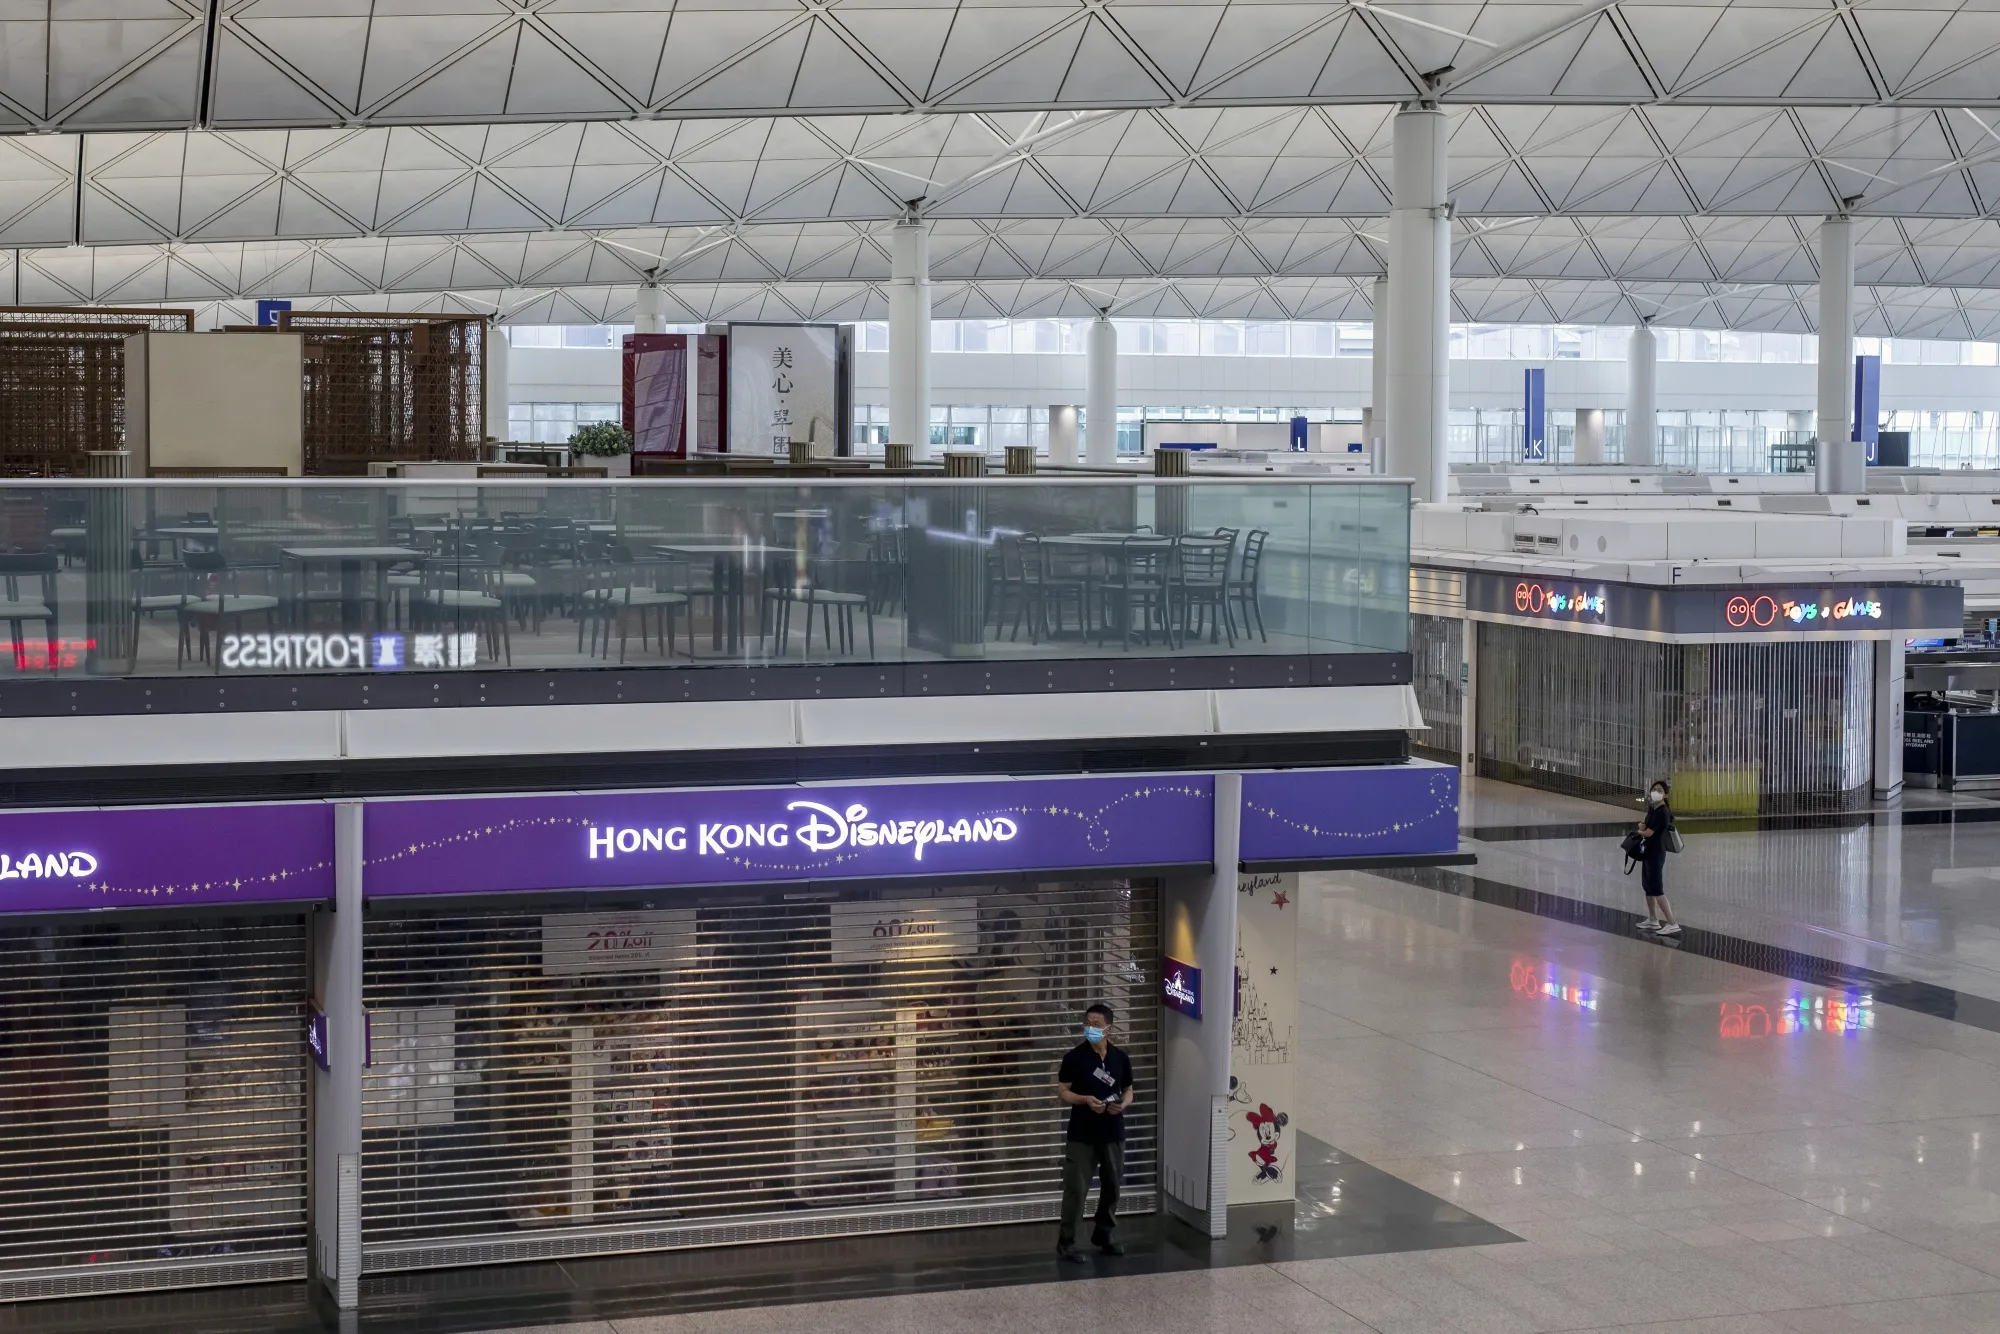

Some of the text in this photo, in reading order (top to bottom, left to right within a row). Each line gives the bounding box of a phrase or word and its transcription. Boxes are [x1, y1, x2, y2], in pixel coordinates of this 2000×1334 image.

[1297, 436, 1305, 451] L
[1533, 439, 1542, 456] K
[1866, 442, 1875, 462] J
[1672, 566, 1682, 585] F
[1833, 596, 1882, 620] GAMES
[588, 824, 687, 859] HONG
[698, 823, 789, 855] KONG
